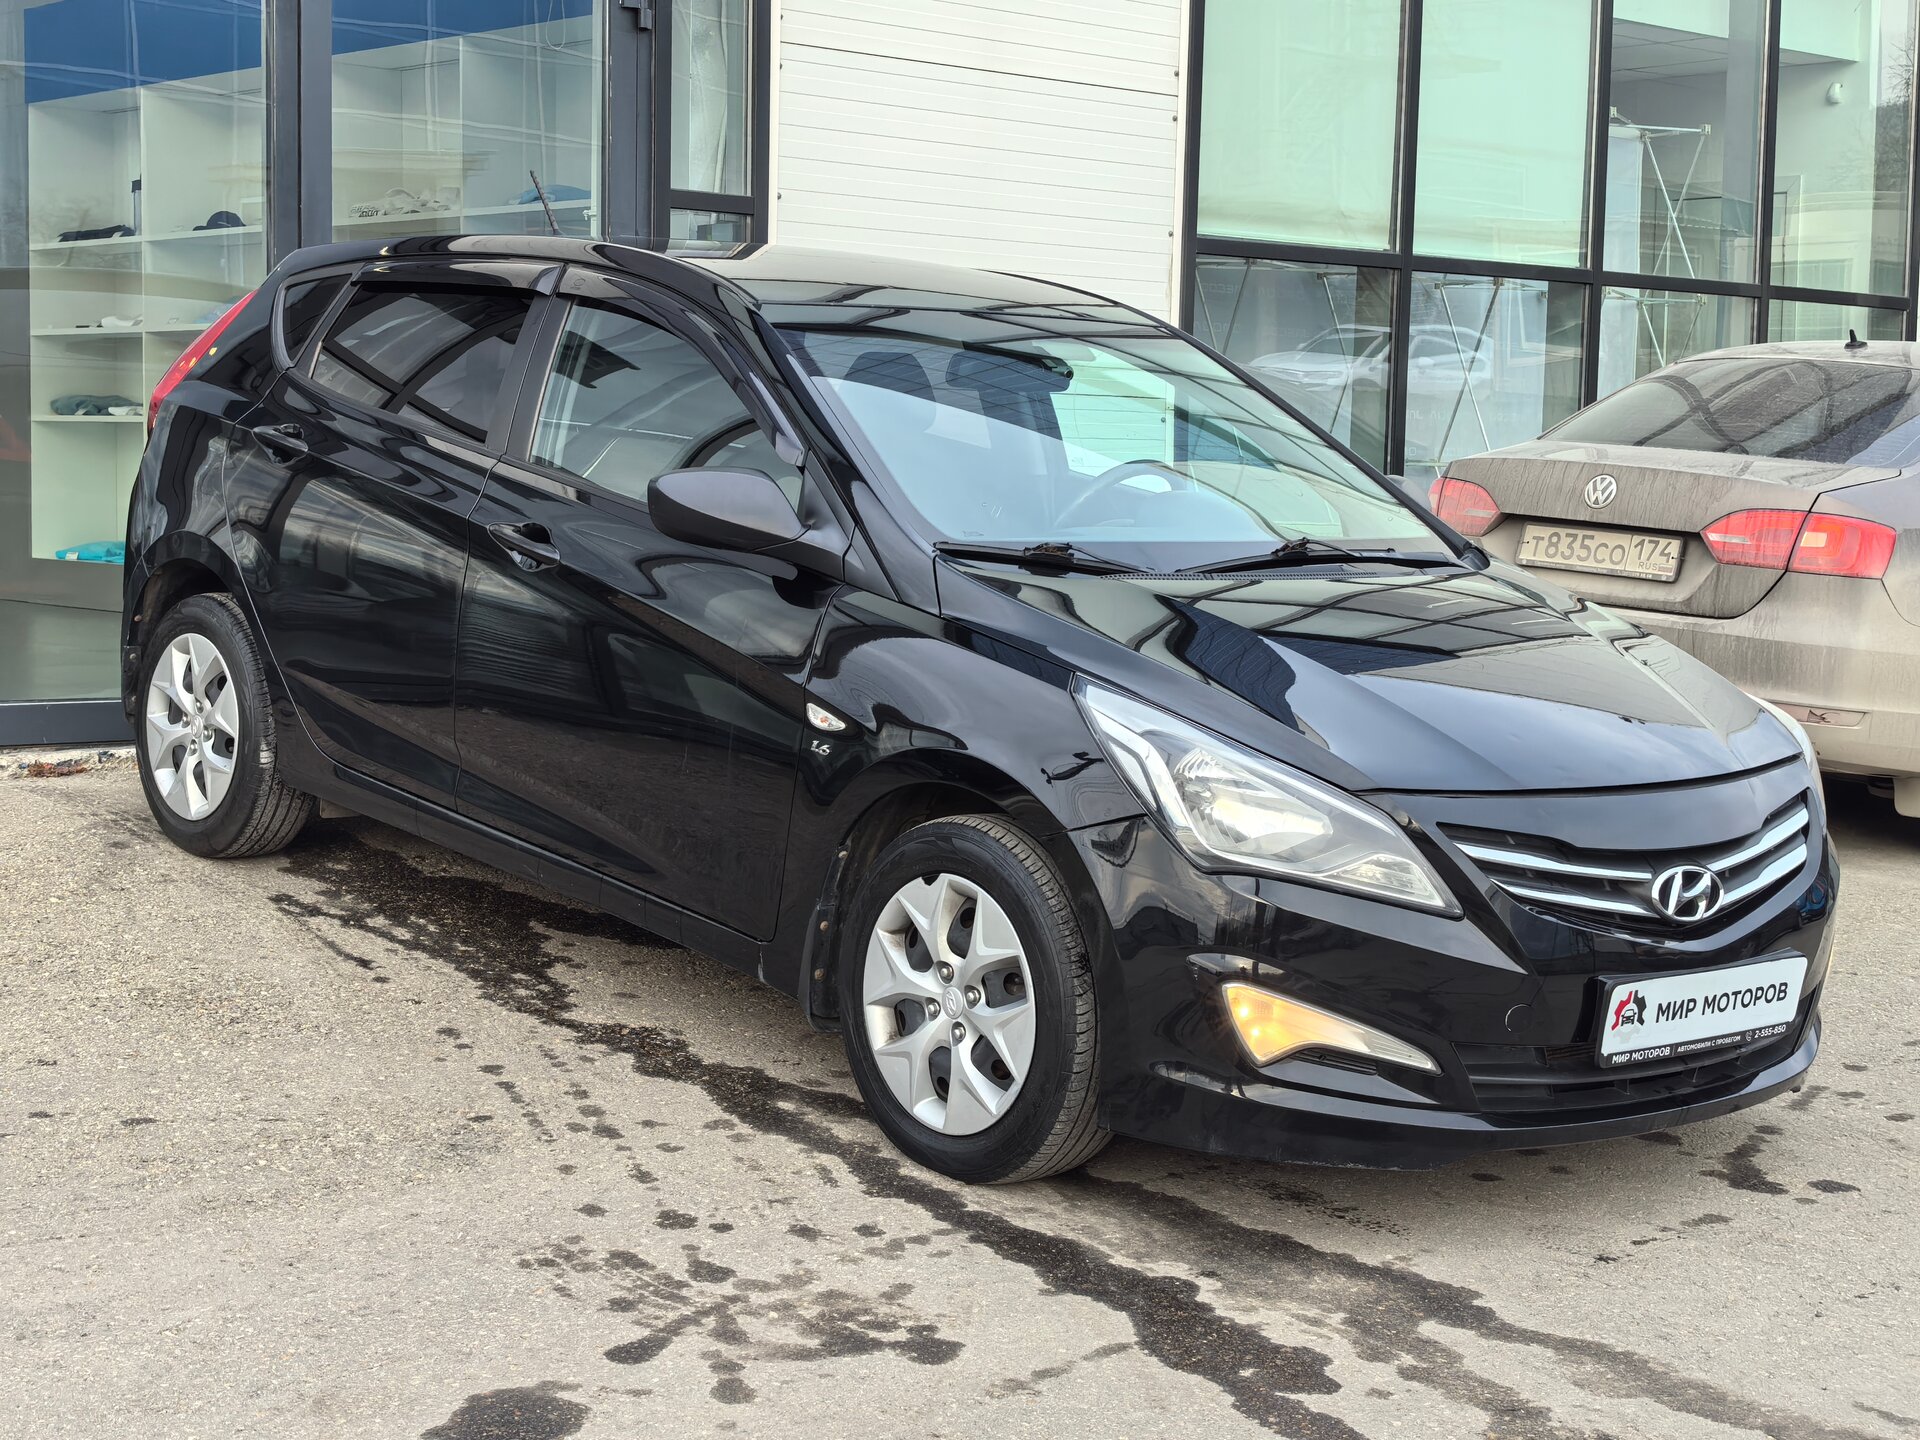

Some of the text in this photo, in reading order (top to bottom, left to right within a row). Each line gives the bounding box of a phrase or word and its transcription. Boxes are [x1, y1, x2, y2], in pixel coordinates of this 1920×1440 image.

[1633, 538, 1673, 564] 174
[1637, 561, 1658, 571] RUS
[1655, 981, 1788, 1024] МИР МОТОРОВ
[1611, 1053, 1630, 1065] МИР
[1631, 1046, 1671, 1062] МОТОРОВ
[1676, 1040, 1711, 1053] АВТОМОБИЛИ
[1716, 1035, 1741, 1046] ПРОБЕГОМ
[1754, 1024, 1787, 1039] 2-555-850
